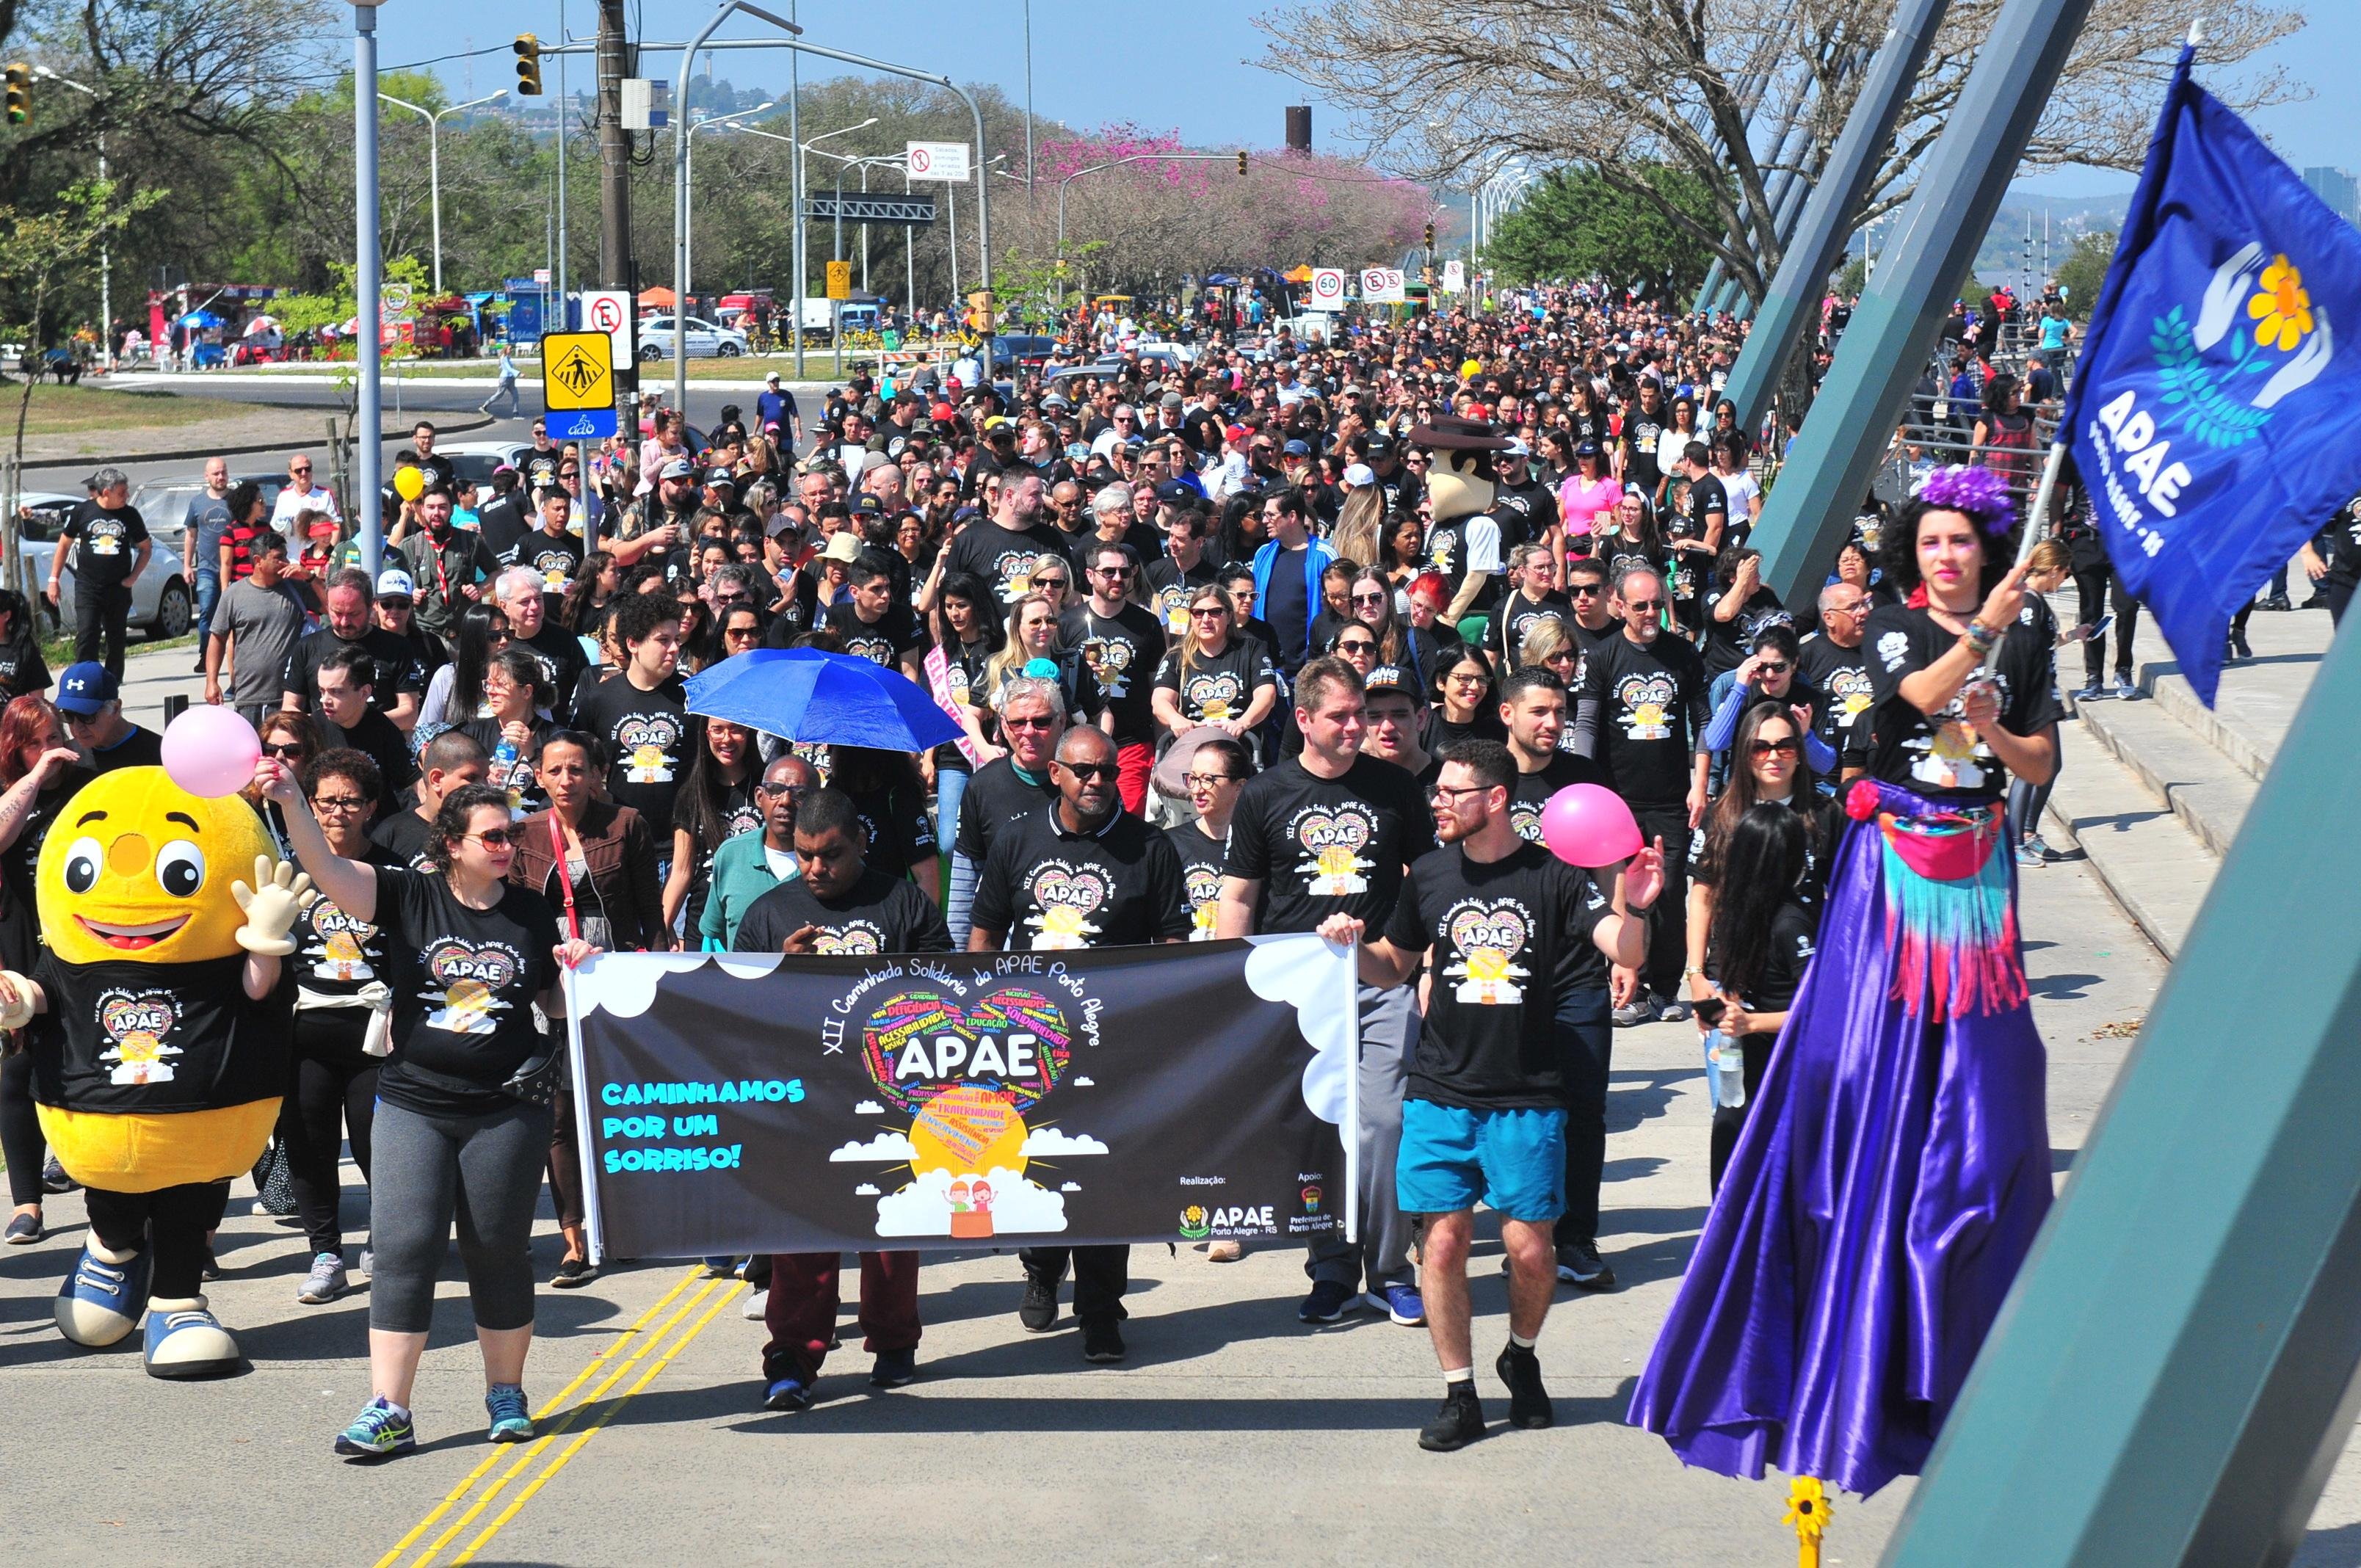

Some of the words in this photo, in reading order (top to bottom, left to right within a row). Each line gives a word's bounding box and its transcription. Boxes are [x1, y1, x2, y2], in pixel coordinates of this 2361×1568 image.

[1321, 277, 1336, 288] 60
[601, 305, 611, 326] E
[2098, 390, 2192, 518] APAE
[545, 562, 567, 570] APAE
[1100, 653, 1123, 664] PAE
[1198, 687, 1230, 699] APAE
[1841, 682, 1874, 693] APAE
[1631, 691, 1666, 703] APAE
[630, 732, 667, 744] APAE
[1312, 827, 1358, 844] APAE
[1084, 863, 1100, 872] APAE
[1044, 885, 1092, 905] APAE
[1498, 898, 1516, 907] APAE
[323, 916, 369, 932] APAE
[849, 919, 866, 928] APAE
[1463, 928, 1513, 946] APAE
[443, 960, 501, 981] APAE
[996, 955, 1043, 976] APAE
[910, 959, 968, 997] Solidária
[973, 968, 992, 987] da
[1048, 962, 1085, 998] Porto
[833, 960, 903, 1014] Caminhada
[887, 1001, 940, 1016] DEFICIÊNCIA
[993, 997, 1045, 1008] NECESSIDADES
[115, 1012, 162, 1031] APAE
[871, 1010, 887, 1019] VIDA
[878, 1010, 946, 1046] ACESSIBILIDADE
[966, 1018, 1007, 1028] EDUCAÇÃO
[1004, 1006, 1070, 1048] SOLIDARIEDADE
[1080, 998, 1103, 1048] Alegre
[822, 1017, 845, 1055] XII
[884, 1037, 907, 1051] JUSTIÇA
[896, 1034, 1037, 1080] APAE
[602, 1079, 805, 1106] CAMINHAMOS
[960, 1082, 998, 1092] MOVIMENTO
[981, 1091, 1016, 1104] AMOR
[939, 1104, 1004, 1119] FRATERNIDADE
[602, 1114, 667, 1139] POR
[673, 1114, 718, 1136] UM
[907, 1104, 982, 1151] DESENVOLVIMENTO
[949, 1118, 990, 1144] ASSISTÊNCIA
[603, 1144, 741, 1173] SORRISO!
[1180, 1176, 1226, 1186] Realização:
[1298, 1173, 1323, 1182] Apoio:
[1211, 1206, 1274, 1227] APAE
[1291, 1216, 1321, 1224] Prefeitura
[1229, 1227, 1258, 1236] Alegre
[1265, 1226, 1277, 1234] RS
[1289, 1224, 1309, 1233] Porto
[1310, 1222, 1333, 1230] Alegre
